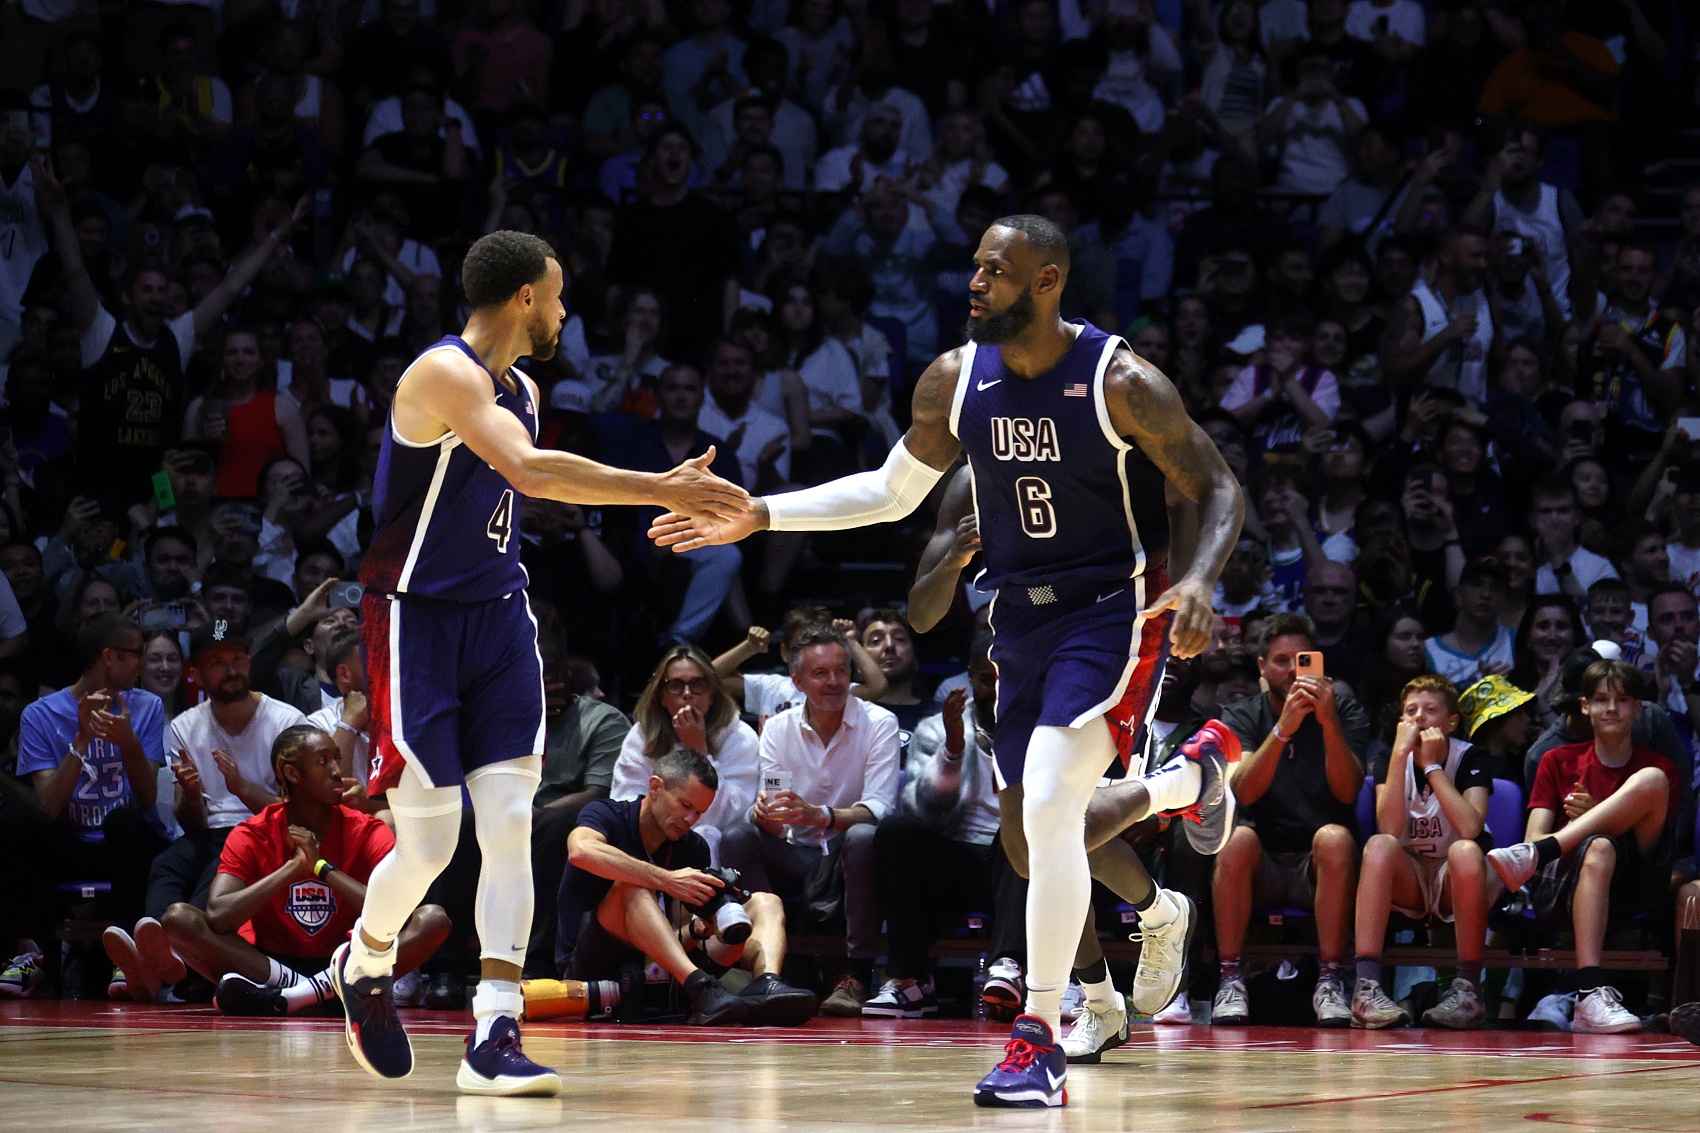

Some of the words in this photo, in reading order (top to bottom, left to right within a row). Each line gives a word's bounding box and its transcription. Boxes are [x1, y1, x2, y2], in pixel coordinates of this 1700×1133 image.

[125, 388, 163, 422] 23
[991, 417, 1061, 462] USA
[487, 488, 513, 554] 4
[1015, 476, 1058, 539] 6
[78, 761, 124, 800] 23
[1408, 816, 1443, 839] USA
[295, 887, 327, 902] USA
